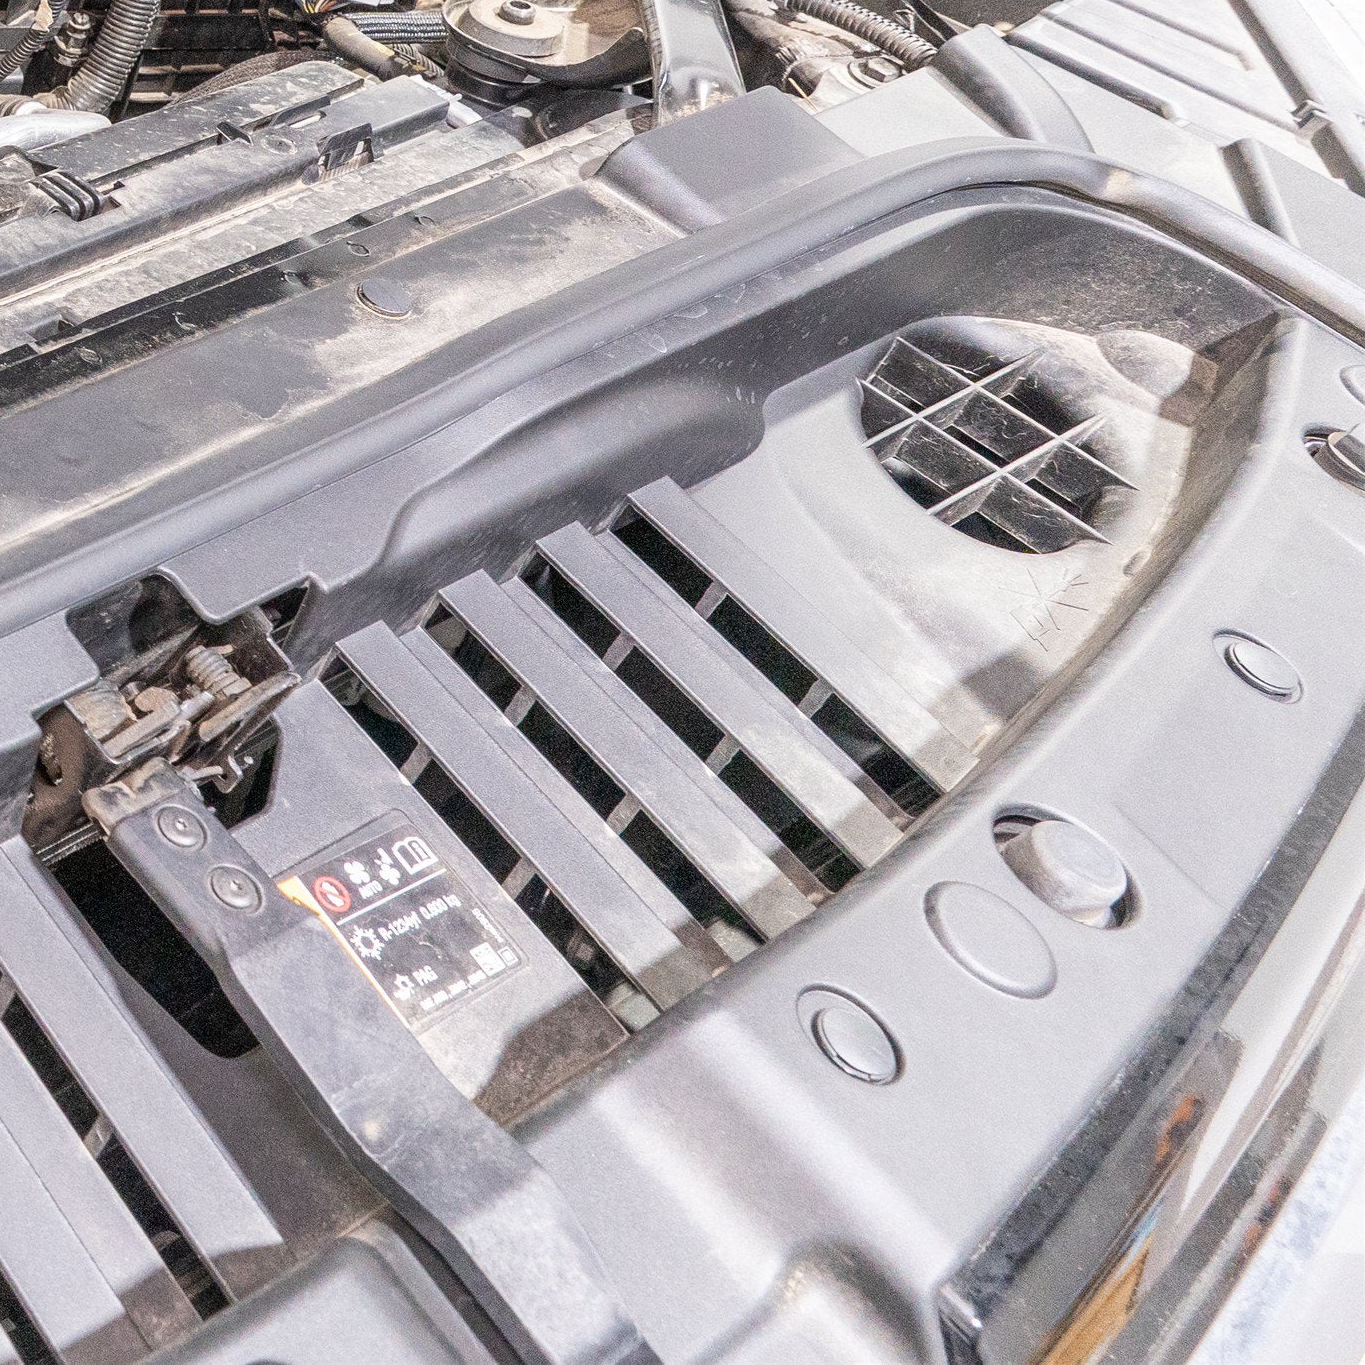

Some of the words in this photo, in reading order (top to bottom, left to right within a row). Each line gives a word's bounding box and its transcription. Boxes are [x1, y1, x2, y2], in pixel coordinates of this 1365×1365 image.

[358, 880, 384, 899] AUTO
[442, 893, 462, 908] kg
[412, 965, 439, 986] PAG
